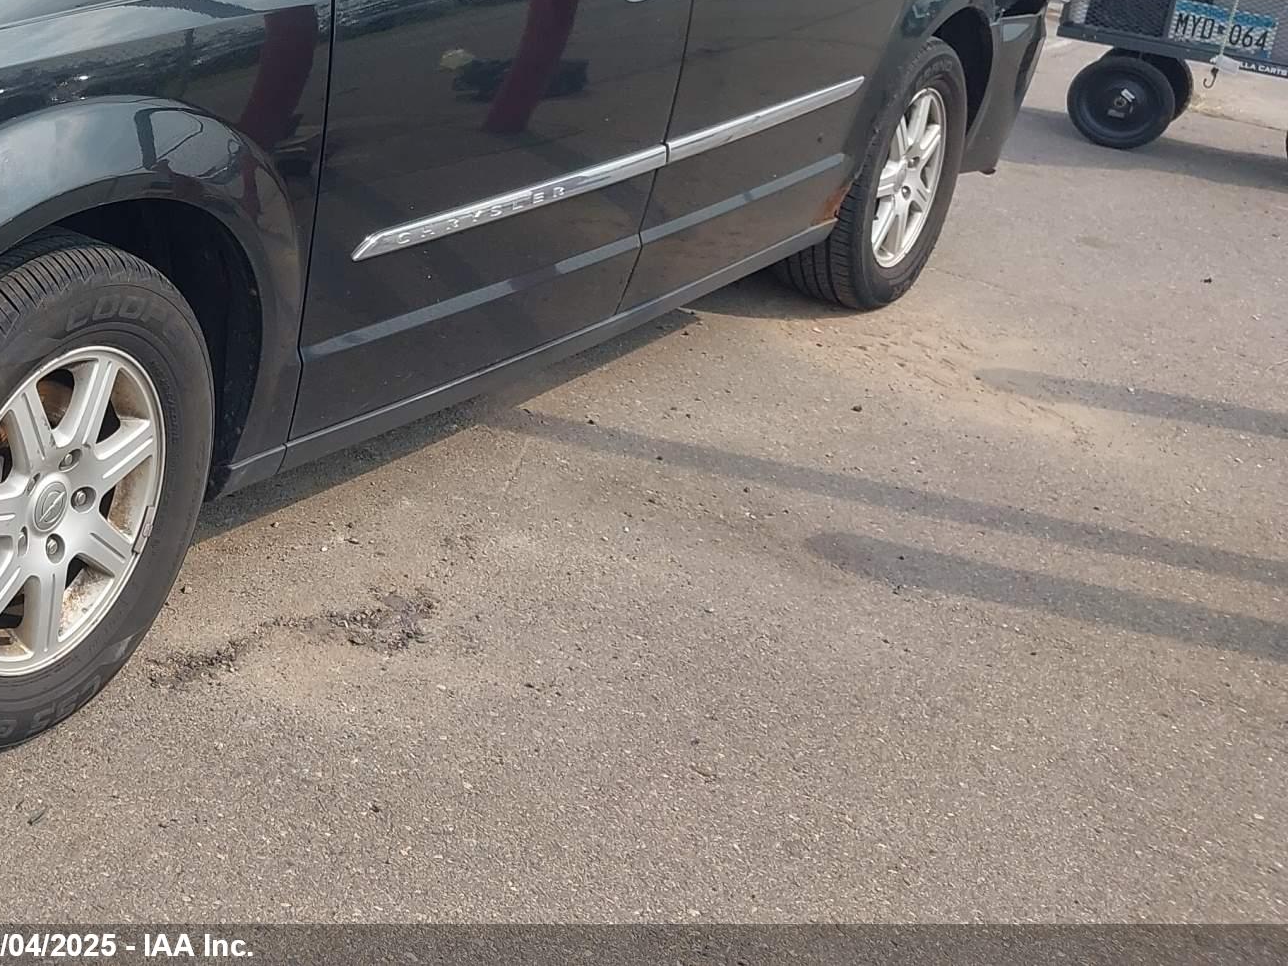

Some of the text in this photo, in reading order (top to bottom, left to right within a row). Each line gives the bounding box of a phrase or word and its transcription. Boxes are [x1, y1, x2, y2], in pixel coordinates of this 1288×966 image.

[1174, 12, 1269, 50] MYD 064
[396, 186, 566, 245] CHRYSLER
